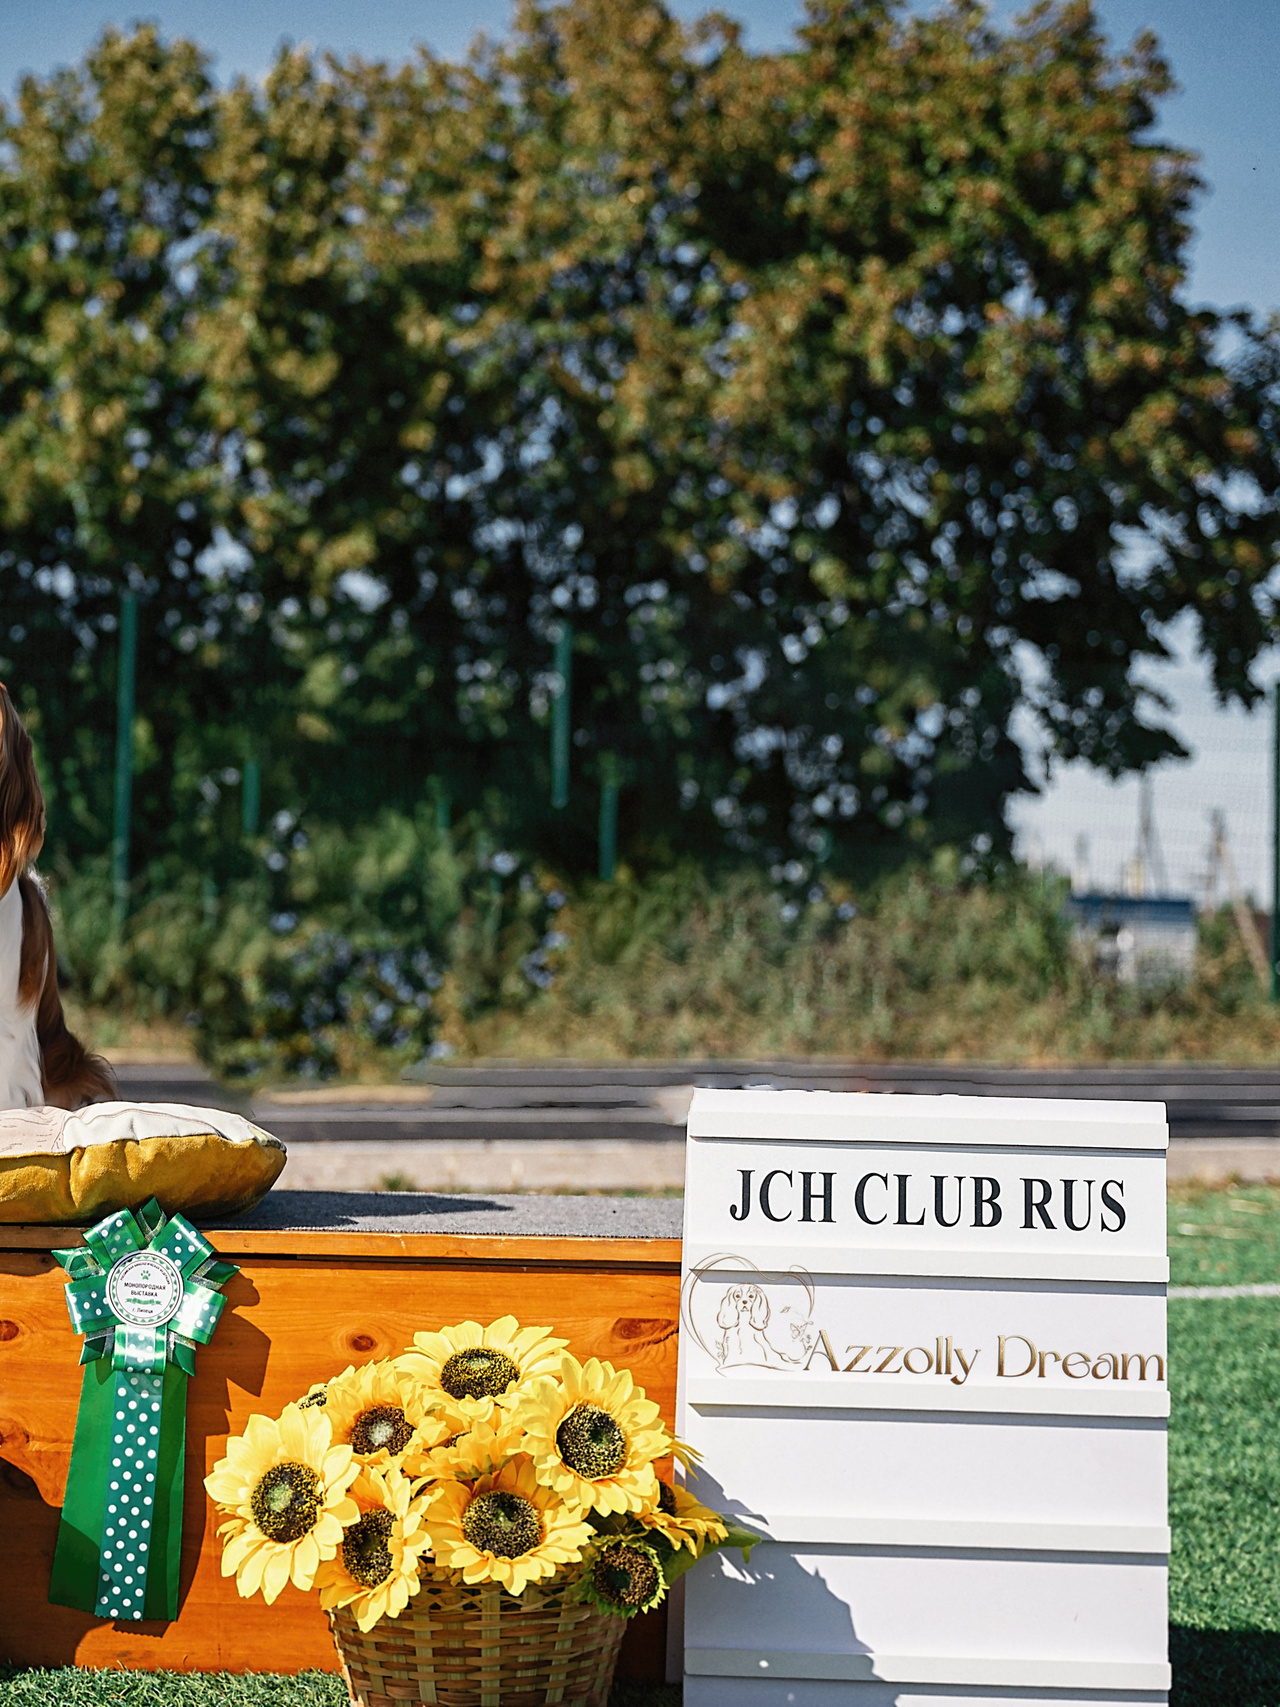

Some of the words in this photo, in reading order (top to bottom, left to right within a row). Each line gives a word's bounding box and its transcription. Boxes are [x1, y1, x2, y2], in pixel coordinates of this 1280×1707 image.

[729, 1169, 837, 1223] JCH
[854, 1172, 1002, 1228] CLUB
[1019, 1177, 1126, 1232] RUS
[124, 1282, 166, 1290] МОНОПОРОДНАЯ
